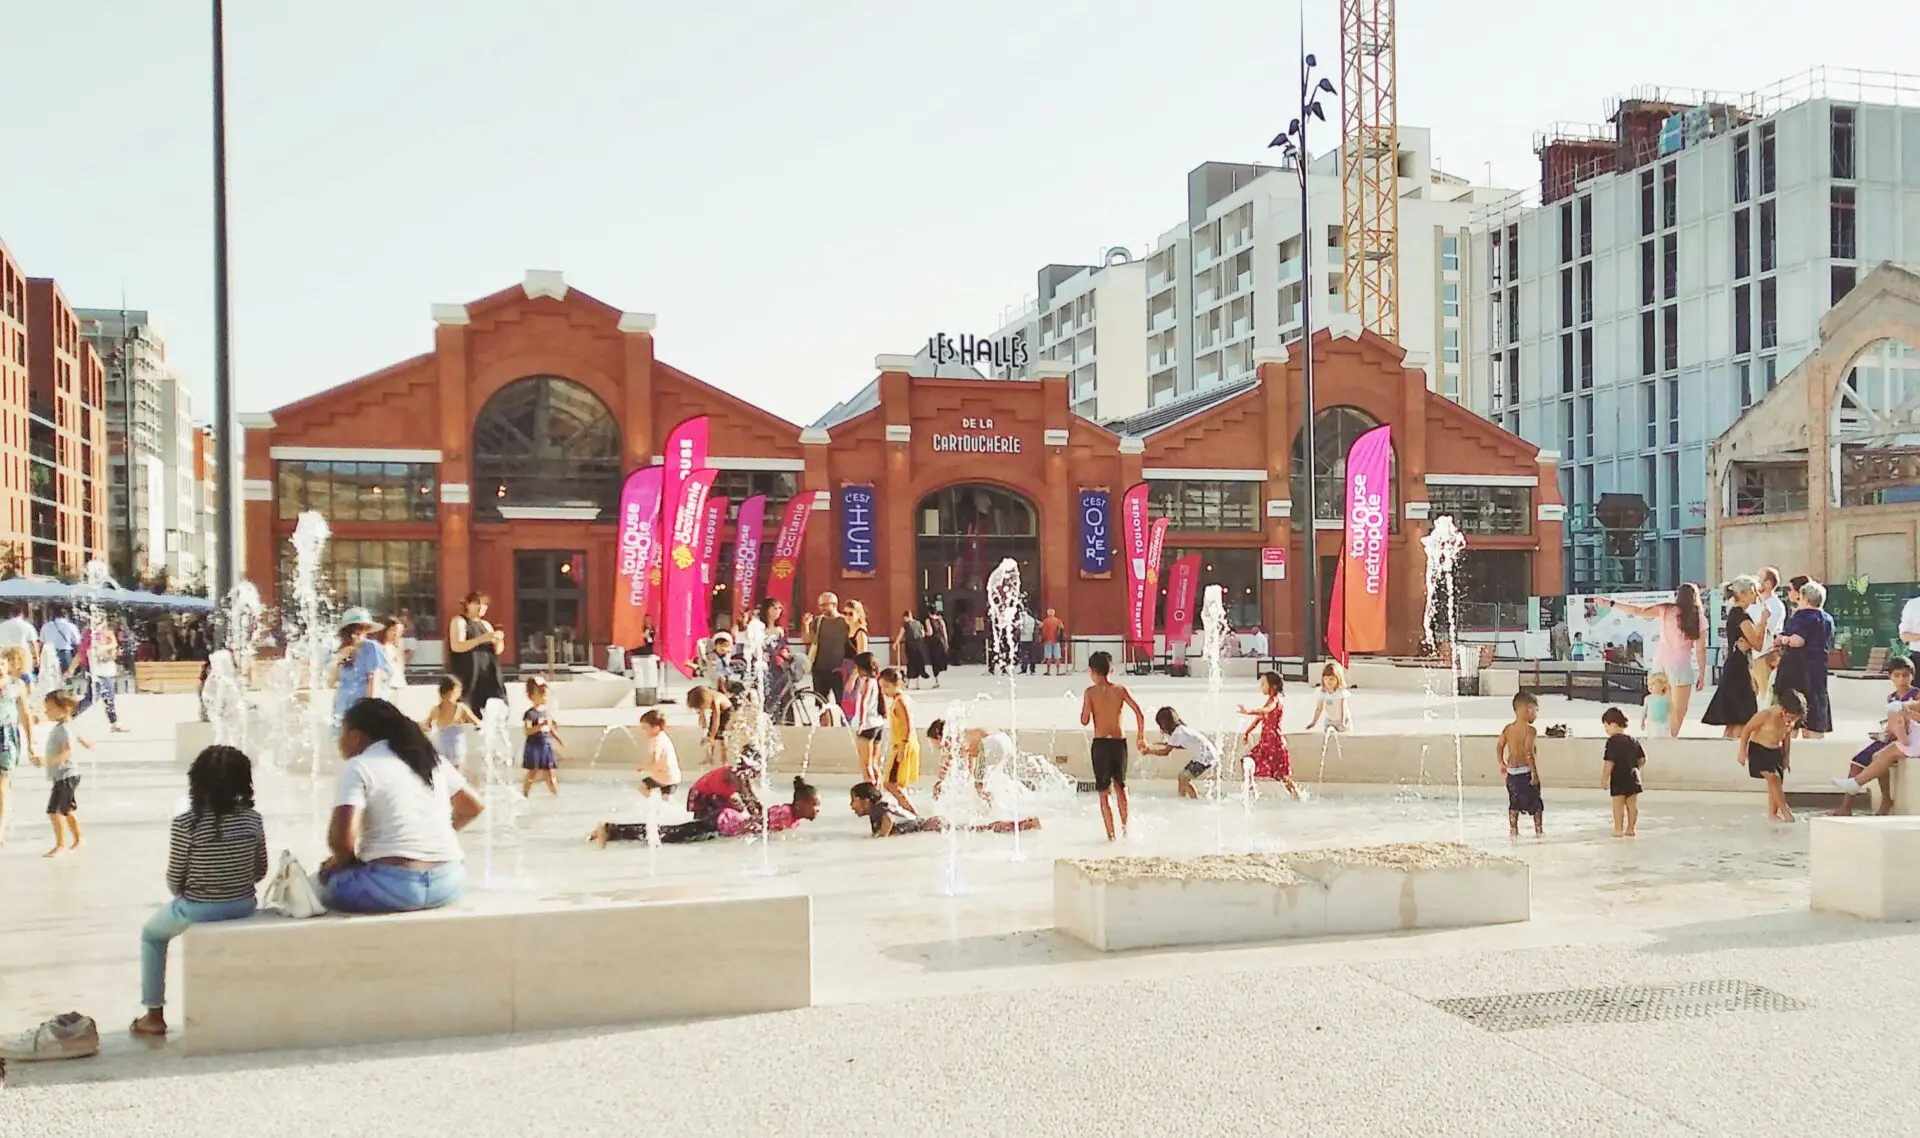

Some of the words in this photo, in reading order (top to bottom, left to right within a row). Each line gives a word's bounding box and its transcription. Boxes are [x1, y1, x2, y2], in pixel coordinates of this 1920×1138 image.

[928, 333, 954, 364] LES
[960, 334, 1028, 368] HALLES
[962, 418, 976, 429] DE
[980, 418, 994, 429] LA
[933, 433, 1021, 453] CARTOUCHERIE
[845, 493, 871, 504] C'EST
[1083, 497, 1106, 507] C'EST
[704, 508, 718, 559] TOULOUSE
[1132, 498, 1144, 554] TOULOUSE
